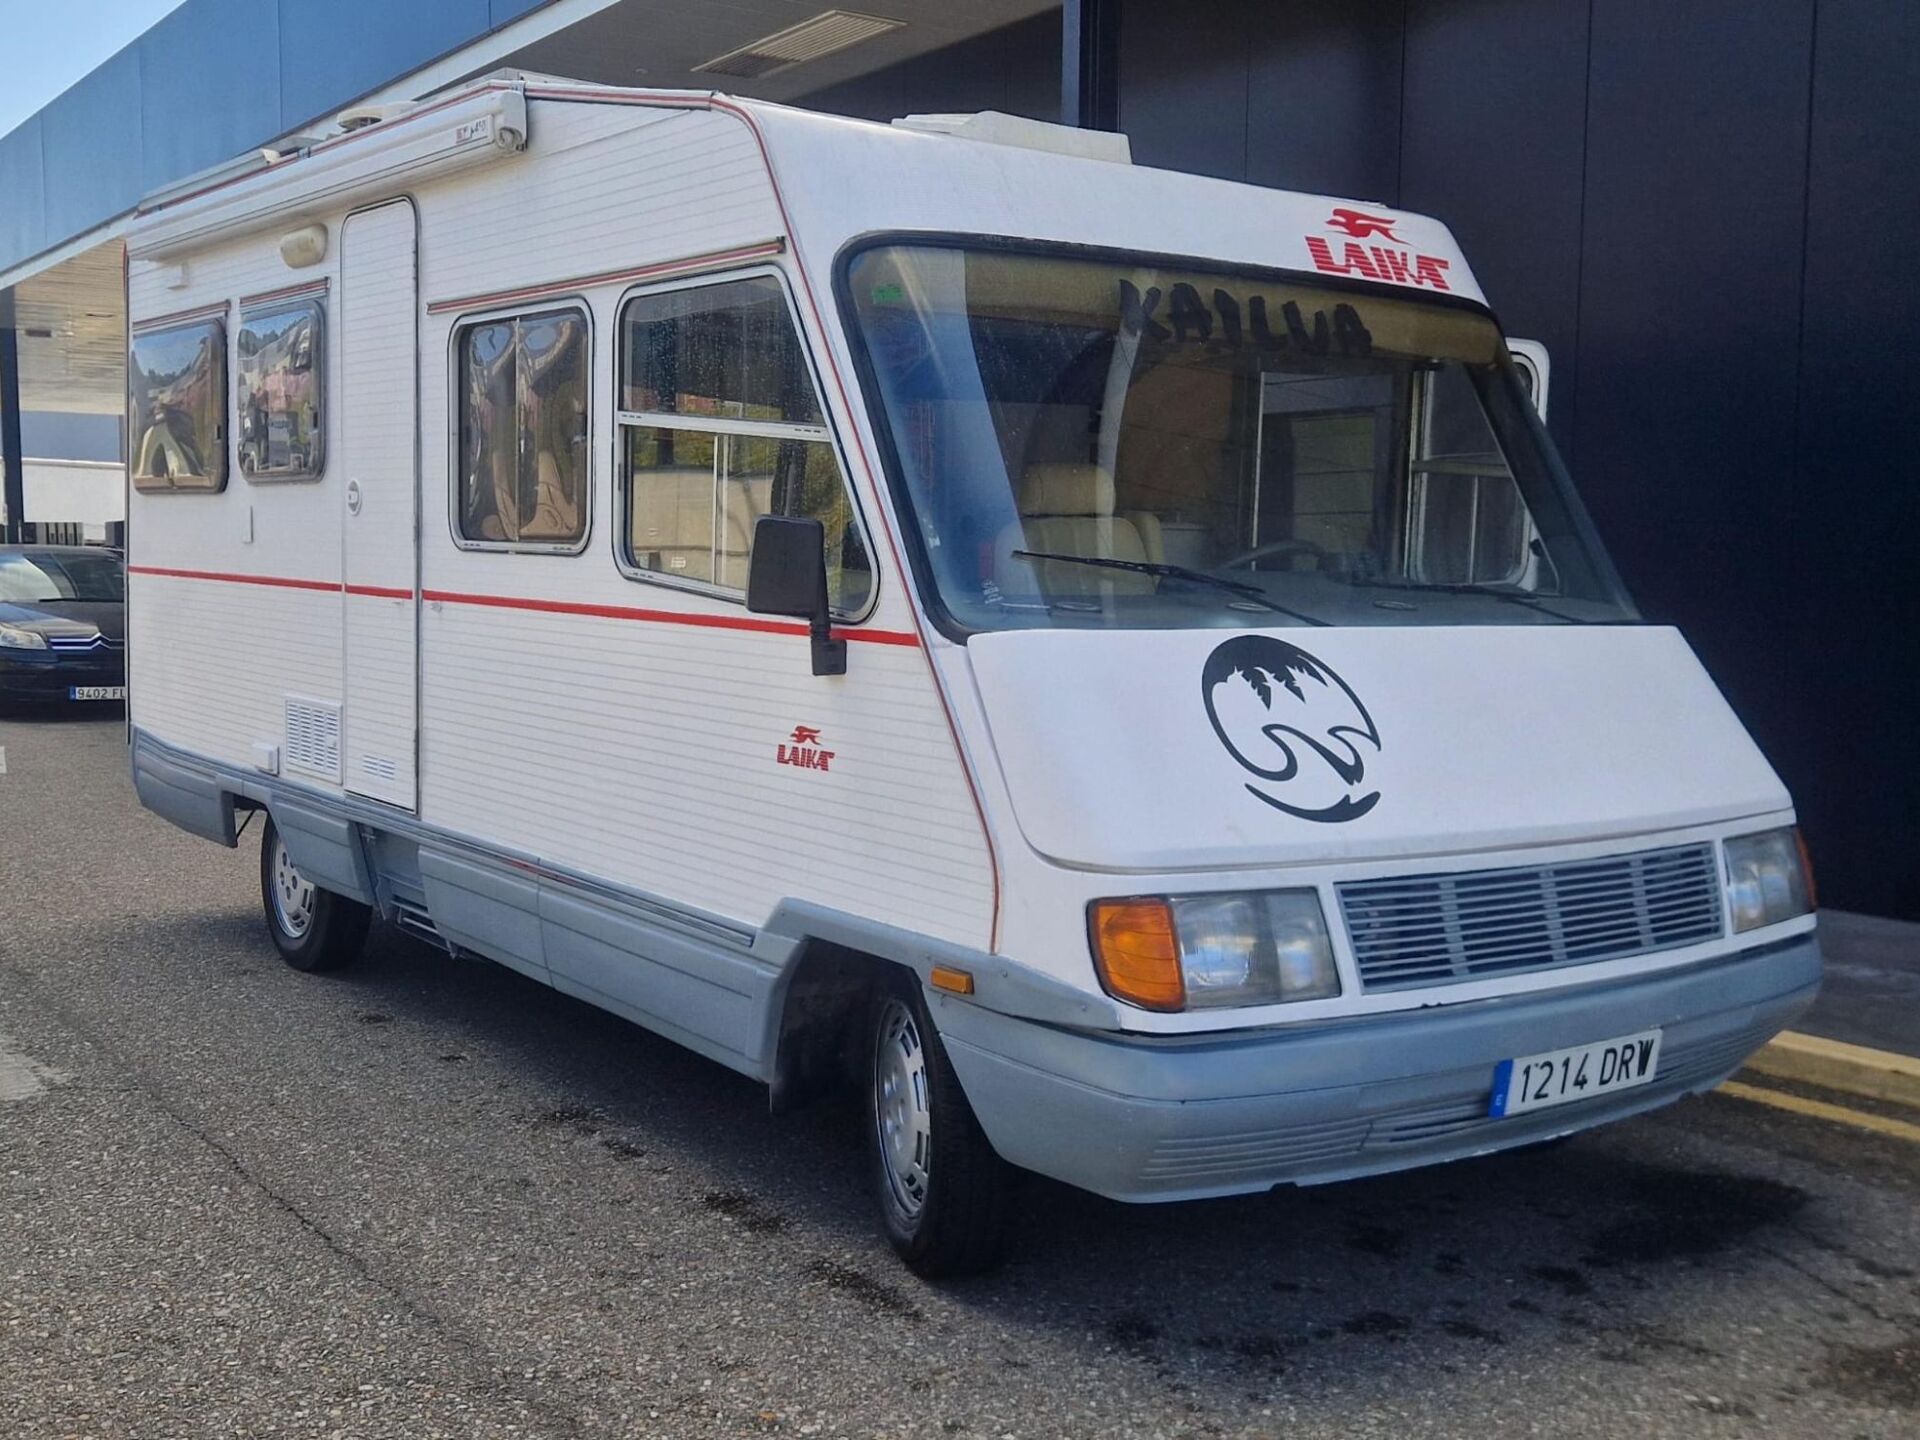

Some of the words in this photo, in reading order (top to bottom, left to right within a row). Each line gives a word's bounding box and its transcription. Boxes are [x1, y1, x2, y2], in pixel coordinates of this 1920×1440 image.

[1305, 236, 1450, 291] LAIKA
[1119, 278, 1373, 355] KAILUA
[77, 688, 108, 699] 9402
[777, 744, 835, 771] LAIKA
[1521, 1052, 1590, 1103] 1214
[1598, 1039, 1654, 1086] DRW
